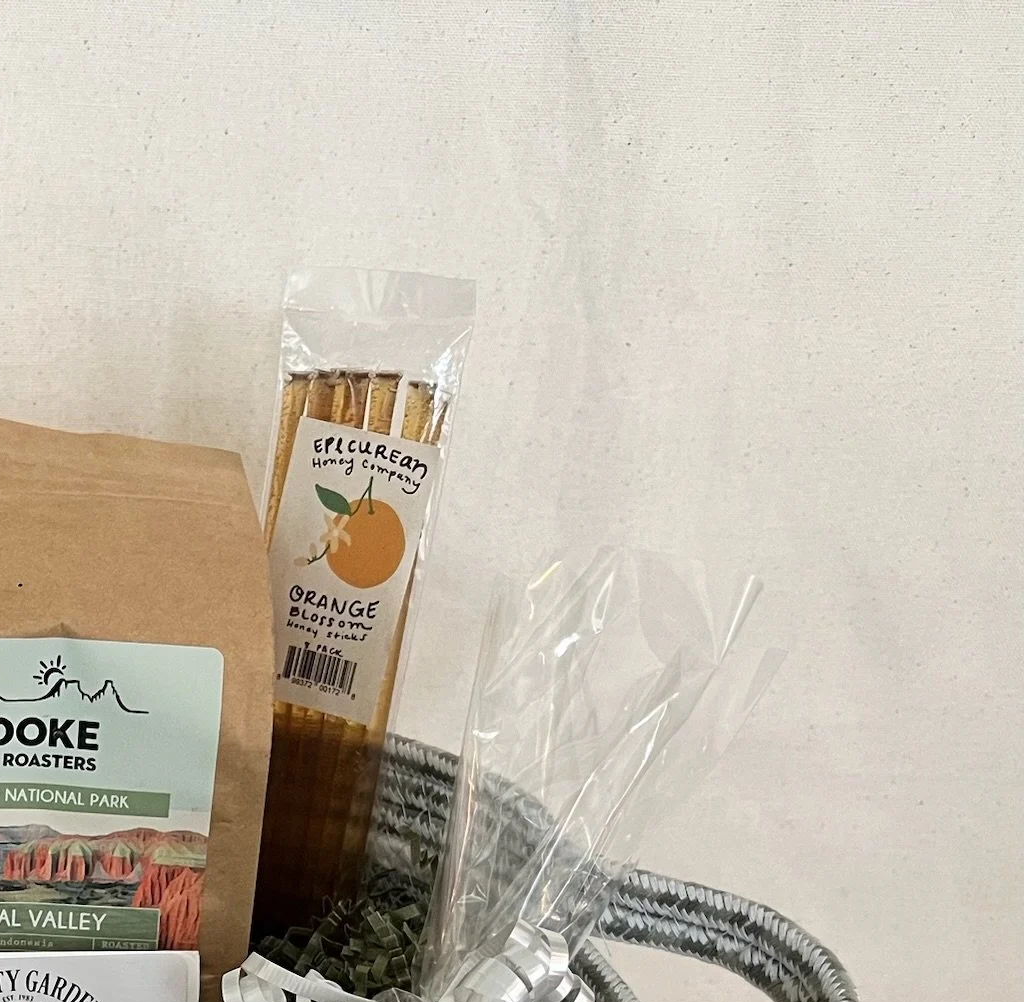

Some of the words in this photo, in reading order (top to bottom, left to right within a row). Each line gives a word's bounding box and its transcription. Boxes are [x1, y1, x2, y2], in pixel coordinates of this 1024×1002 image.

[312, 457, 354, 475] Honey
[289, 585, 380, 619] ORANGE
[317, 644, 343, 657] PACK
[2, 753, 97, 771] ROASTERS
[5, 788, 84, 806] NATIONAL
[90, 793, 129, 809] PARK
[29, 912, 107, 931] VALLEY
